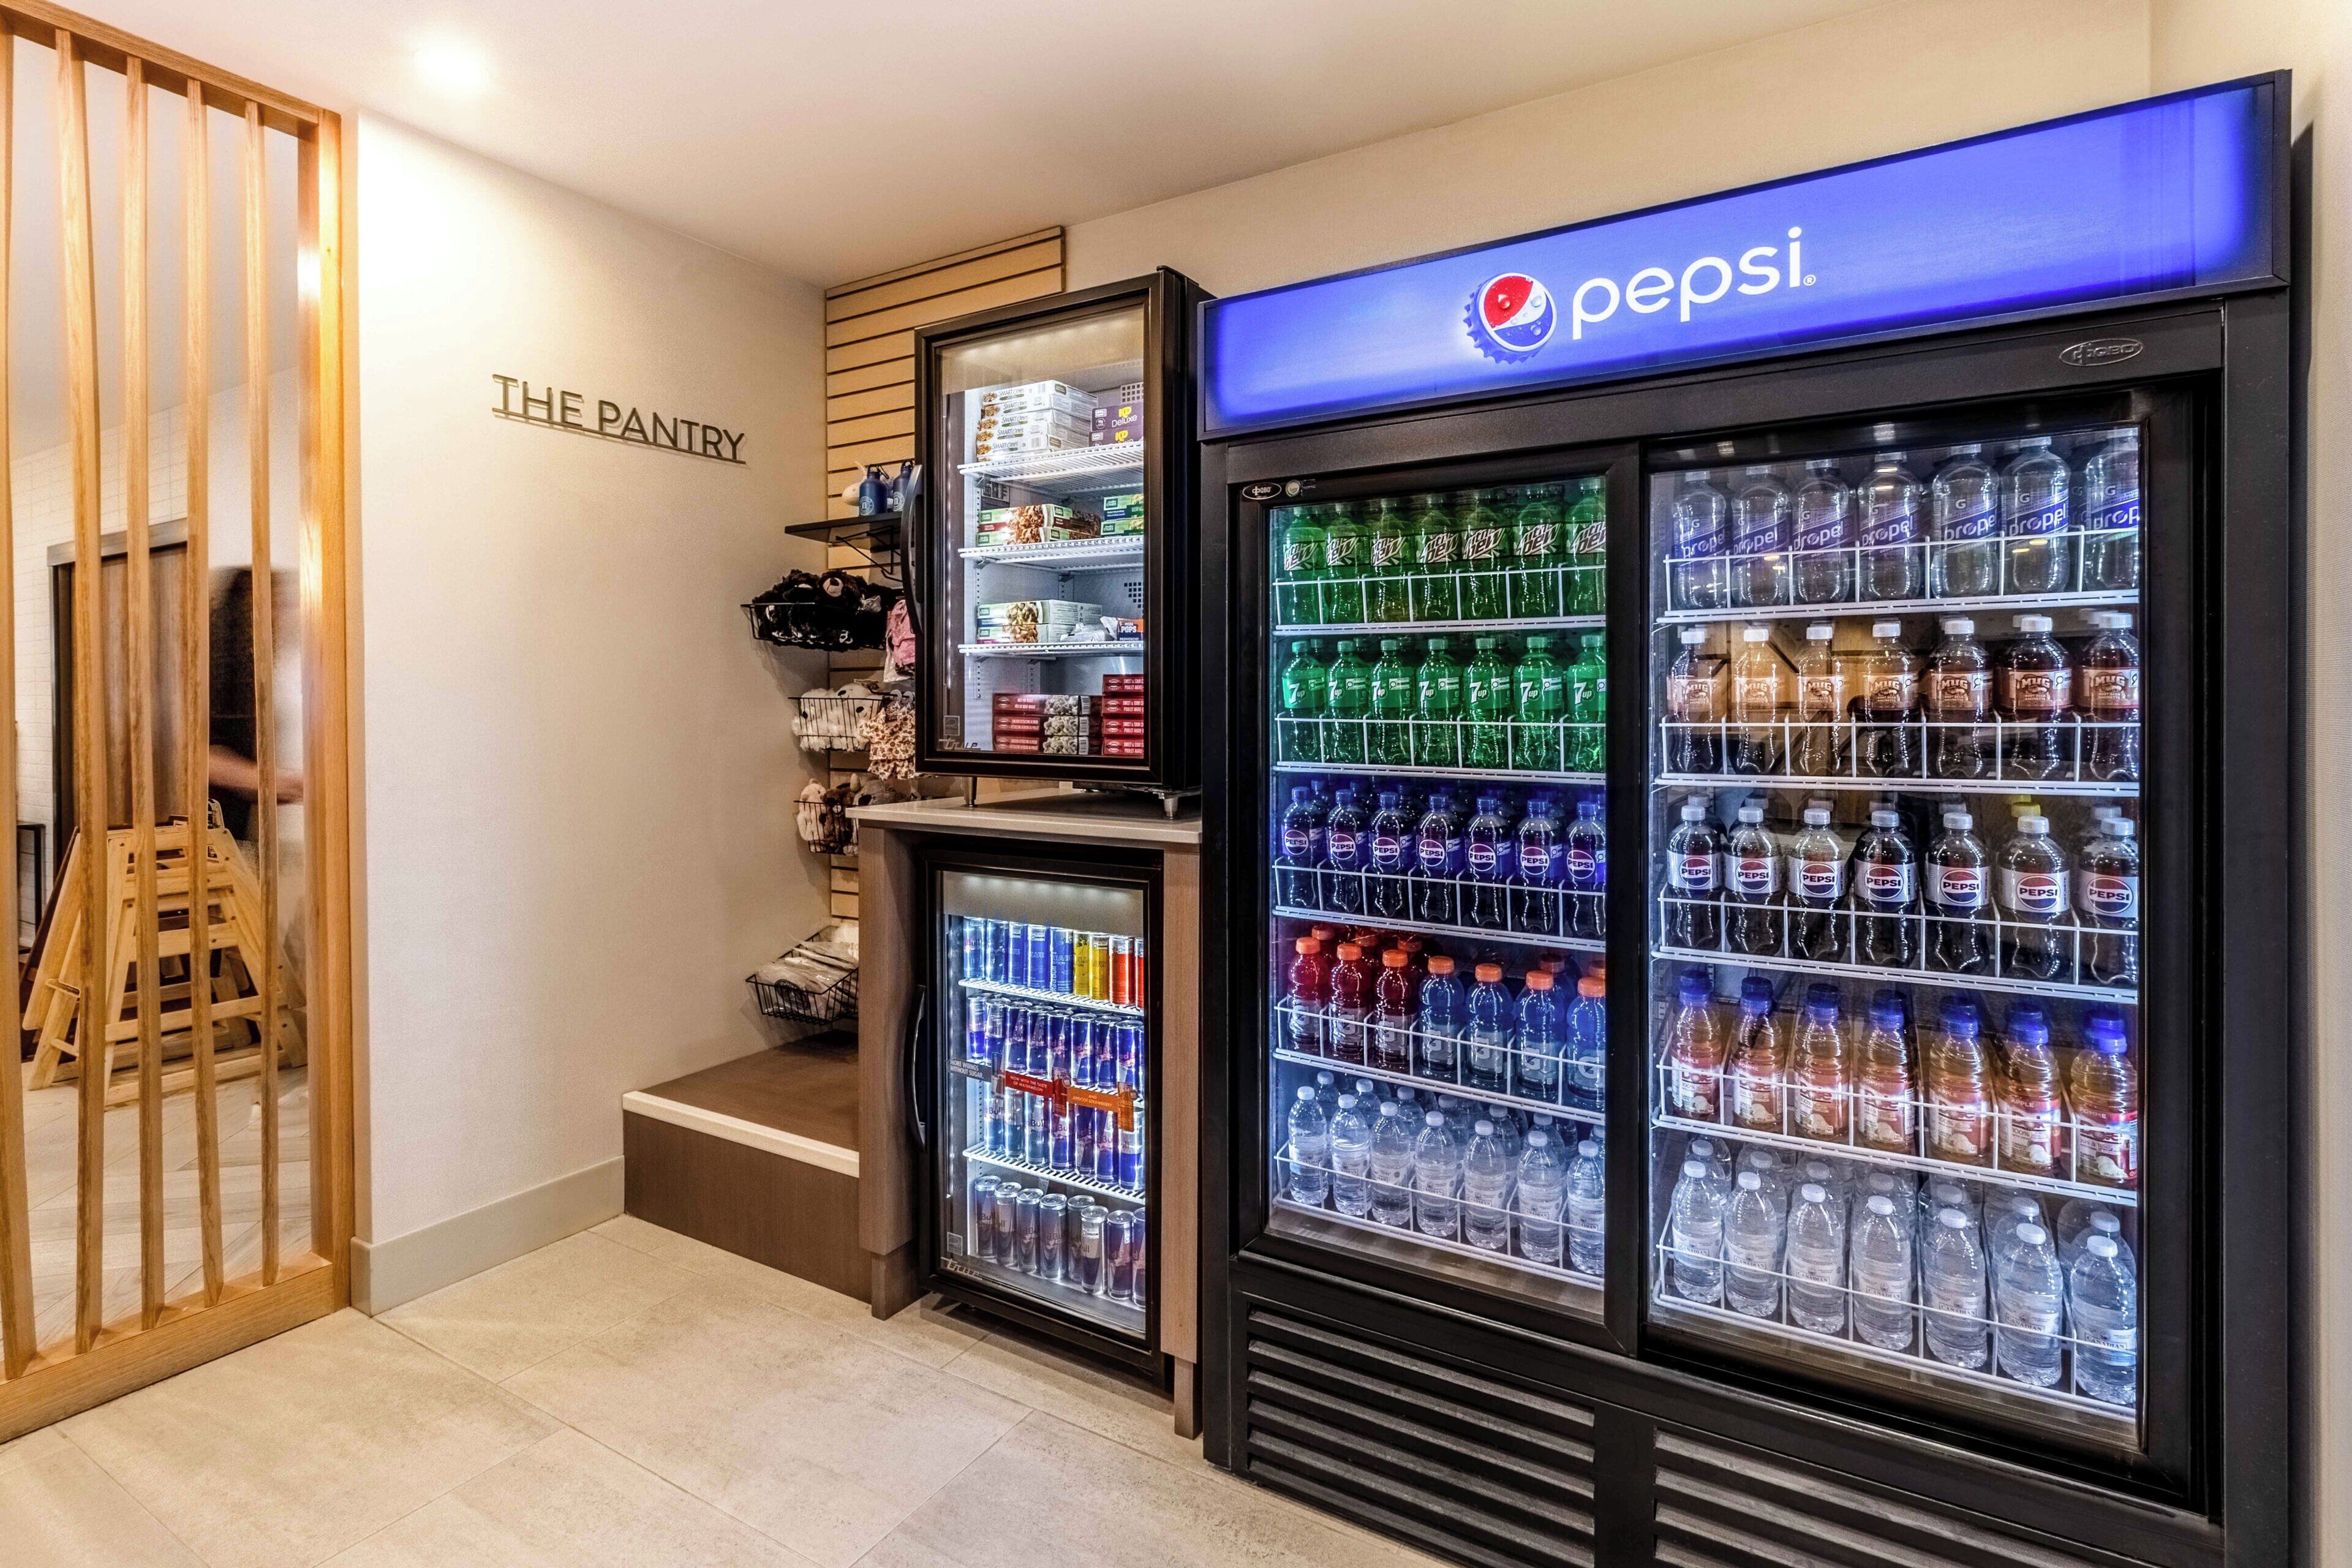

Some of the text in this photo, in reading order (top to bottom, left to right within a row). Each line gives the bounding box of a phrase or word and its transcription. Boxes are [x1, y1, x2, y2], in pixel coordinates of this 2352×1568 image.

[1572, 226, 1802, 341] pepsi
[492, 374, 745, 460] THE PANTRY
[1112, 415, 1137, 428] Deluxe
[2009, 503, 2067, 537] propel
[1793, 521, 1844, 551] propel
[1862, 515, 1913, 547] propel
[1807, 681, 1831, 692] MUG
[1874, 680, 1900, 690] MUG
[1941, 679, 1968, 690] MUG
[2021, 677, 2051, 688] MUG
[2094, 675, 2125, 687] MUG
[1687, 682, 1708, 693] MUG
[1744, 682, 1767, 692] MUG
[1420, 848, 1444, 857] PEPSI
[1567, 859, 1594, 869] PEPSI
[1681, 867, 1711, 876] PEPSI
[1738, 871, 1770, 880] PEPSI
[1803, 874, 1835, 883] PEPSI
[1867, 877, 1901, 887] PEPSI
[1943, 881, 1980, 891] PEPSI
[2019, 888, 2057, 897] PEPSI
[2089, 889, 2130, 901] PEPSI
[950, 1066, 968, 1075] WITHOUT
[2011, 1098, 2034, 1108] APPLE
[2079, 1107, 2107, 1120] POMME
